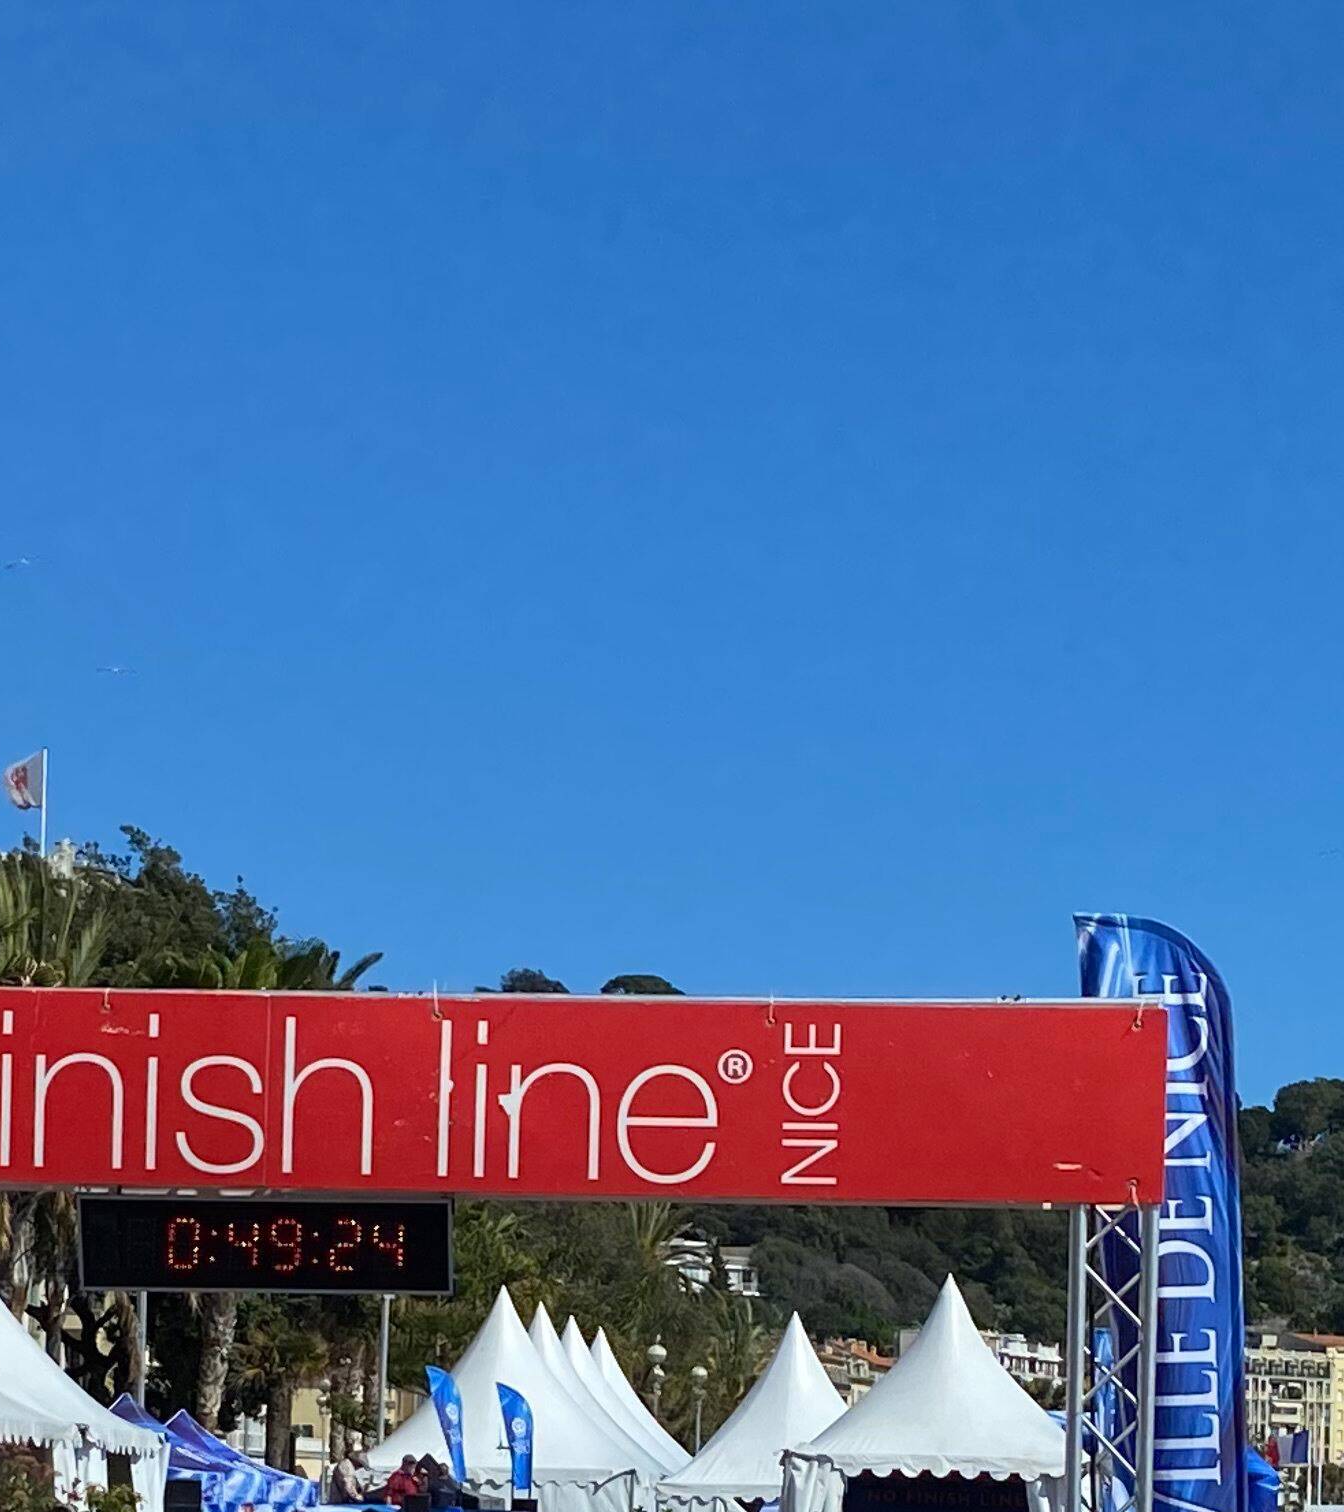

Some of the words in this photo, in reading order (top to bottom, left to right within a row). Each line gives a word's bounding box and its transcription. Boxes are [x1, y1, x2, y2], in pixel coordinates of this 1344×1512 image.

[781, 1022, 841, 1186] NICE
[168, 1217, 405, 1272] 0:49:24
[1156, 1196, 1216, 1303] DE
